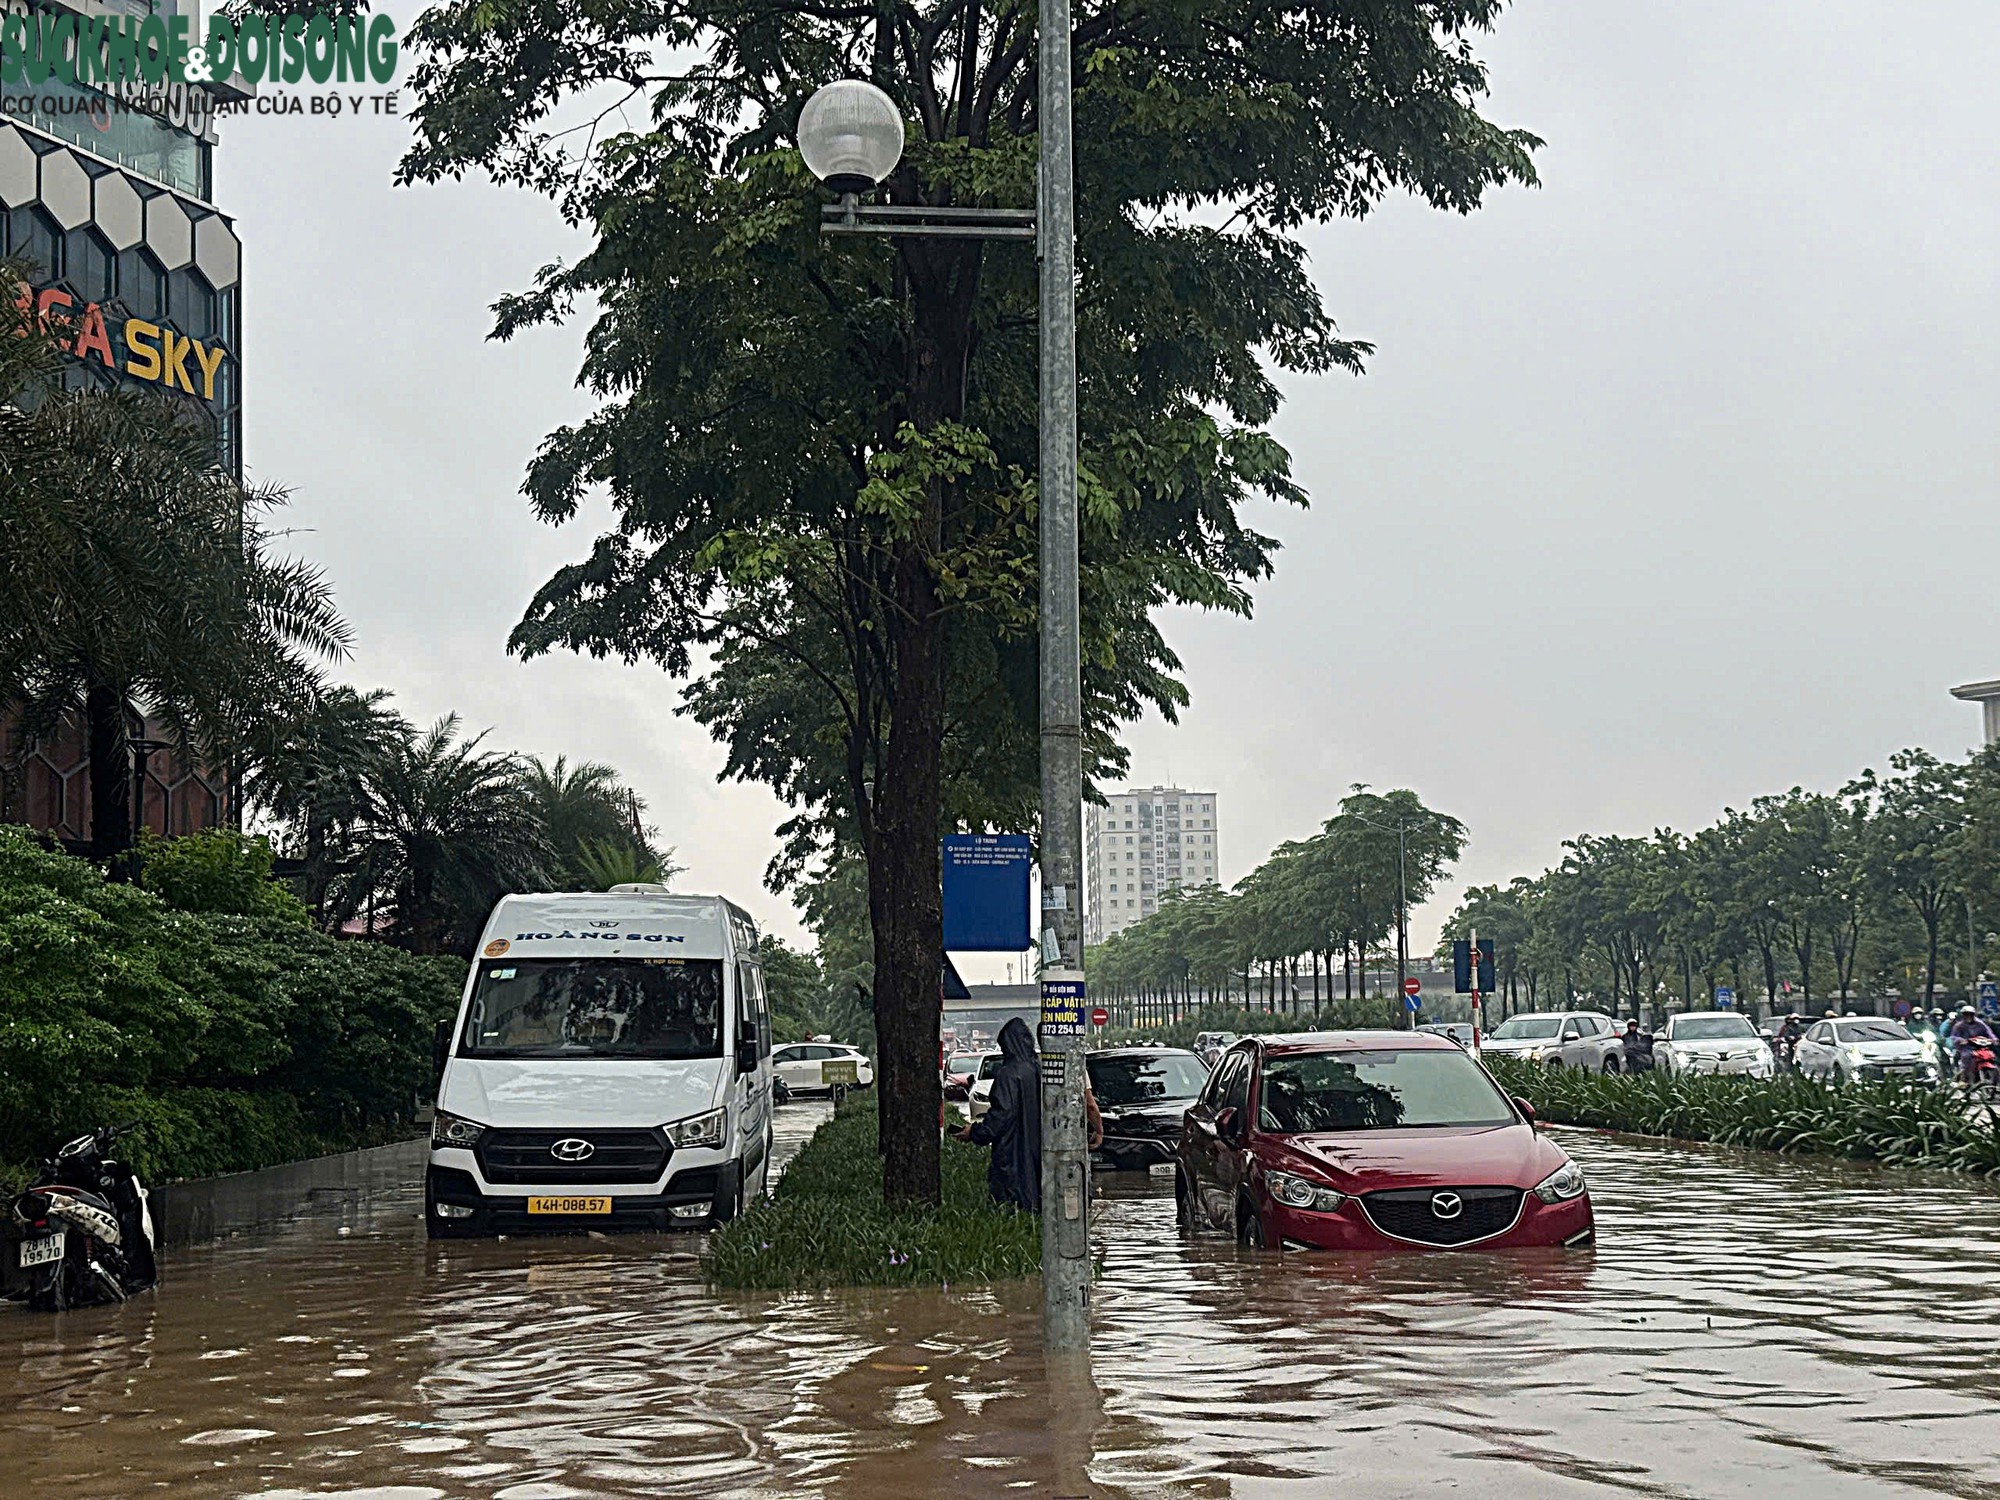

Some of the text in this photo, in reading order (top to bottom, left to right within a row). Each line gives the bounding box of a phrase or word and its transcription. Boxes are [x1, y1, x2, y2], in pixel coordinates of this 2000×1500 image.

[125, 317, 226, 402] SKY
[515, 930, 686, 943] HOÀNG SƠN
[1046, 994, 1063, 1008] CẤP
[1063, 995, 1079, 1011] VẬT
[1054, 1010, 1078, 1023] NƯỚC
[1057, 1024, 1074, 1035] 254
[535, 1200, 605, 1211] 14H-088.57
[23, 1247, 60, 1265] 195.70
